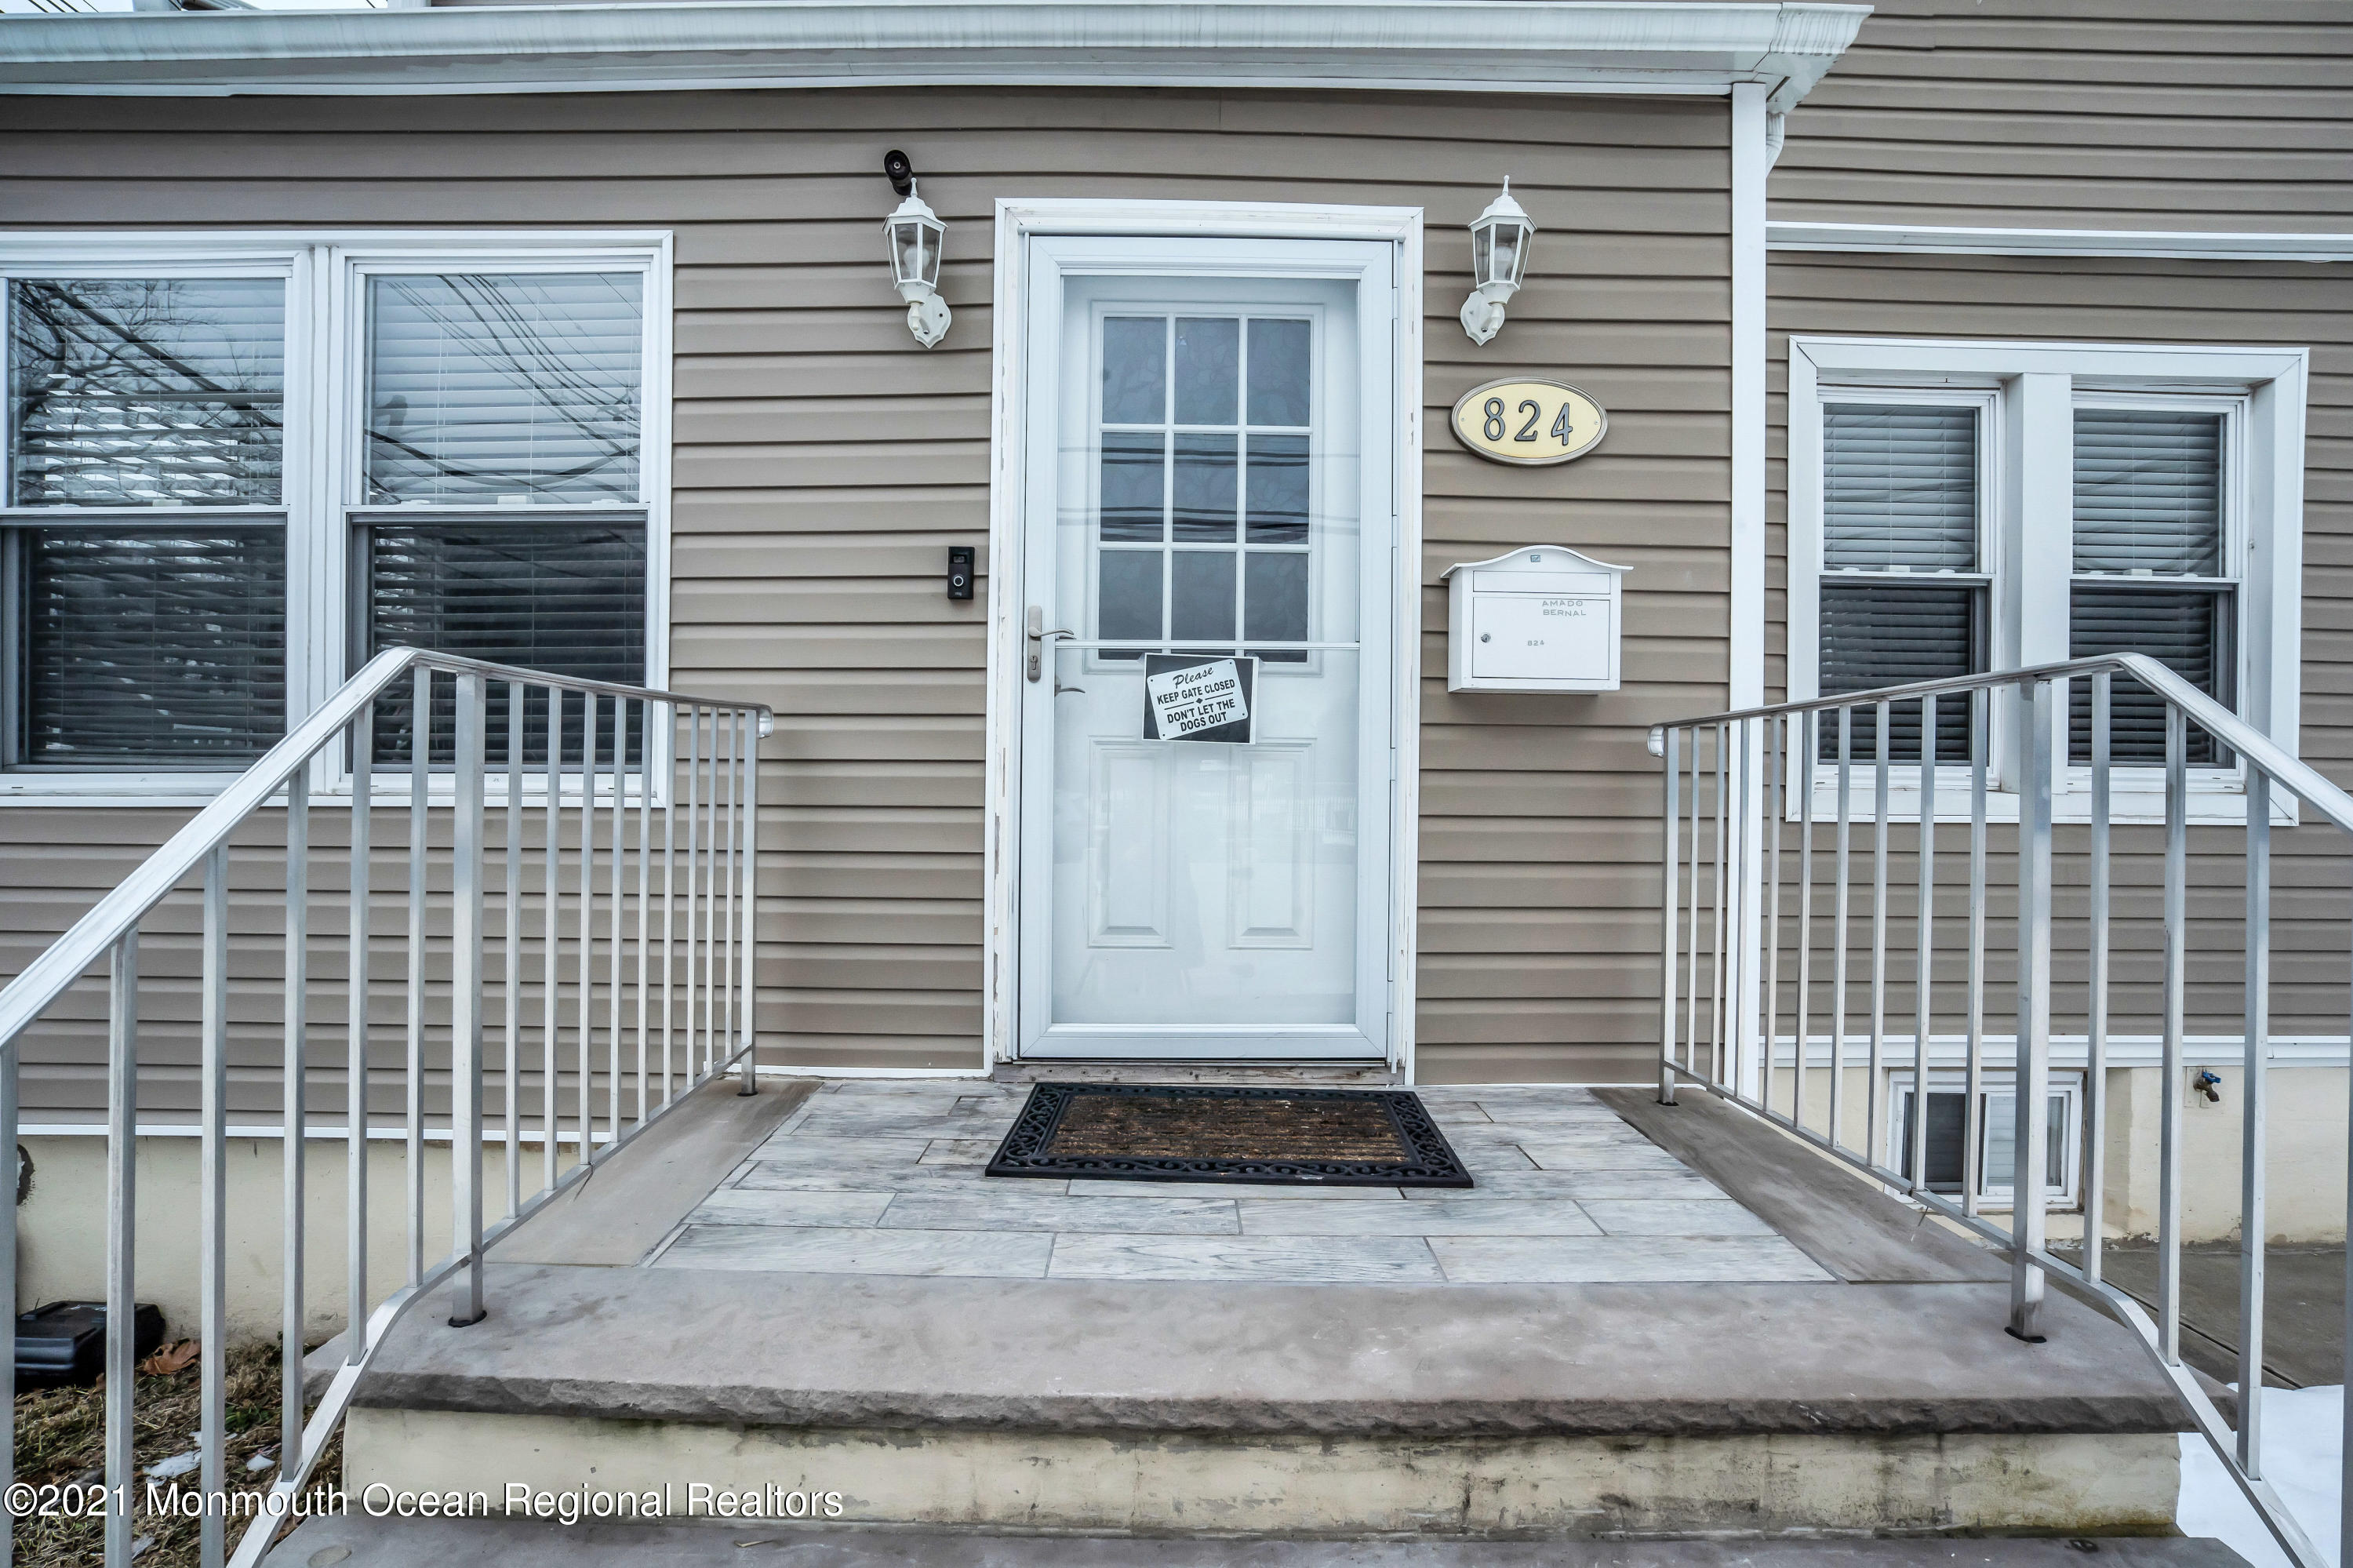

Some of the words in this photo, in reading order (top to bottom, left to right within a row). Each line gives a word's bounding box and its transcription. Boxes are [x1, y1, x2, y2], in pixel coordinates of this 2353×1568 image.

[1483, 397, 1573, 446] 824
[1173, 667, 1213, 689] Please
[1157, 692, 1179, 705] KEEP
[1182, 686, 1202, 699] GATE
[1204, 678, 1235, 694] CLOSED
[1167, 708, 1195, 724] DON'T
[1197, 703, 1214, 715] LET
[1217, 698, 1235, 711] THE
[1180, 717, 1206, 732] DOGS
[1208, 711, 1227, 724] OUT
